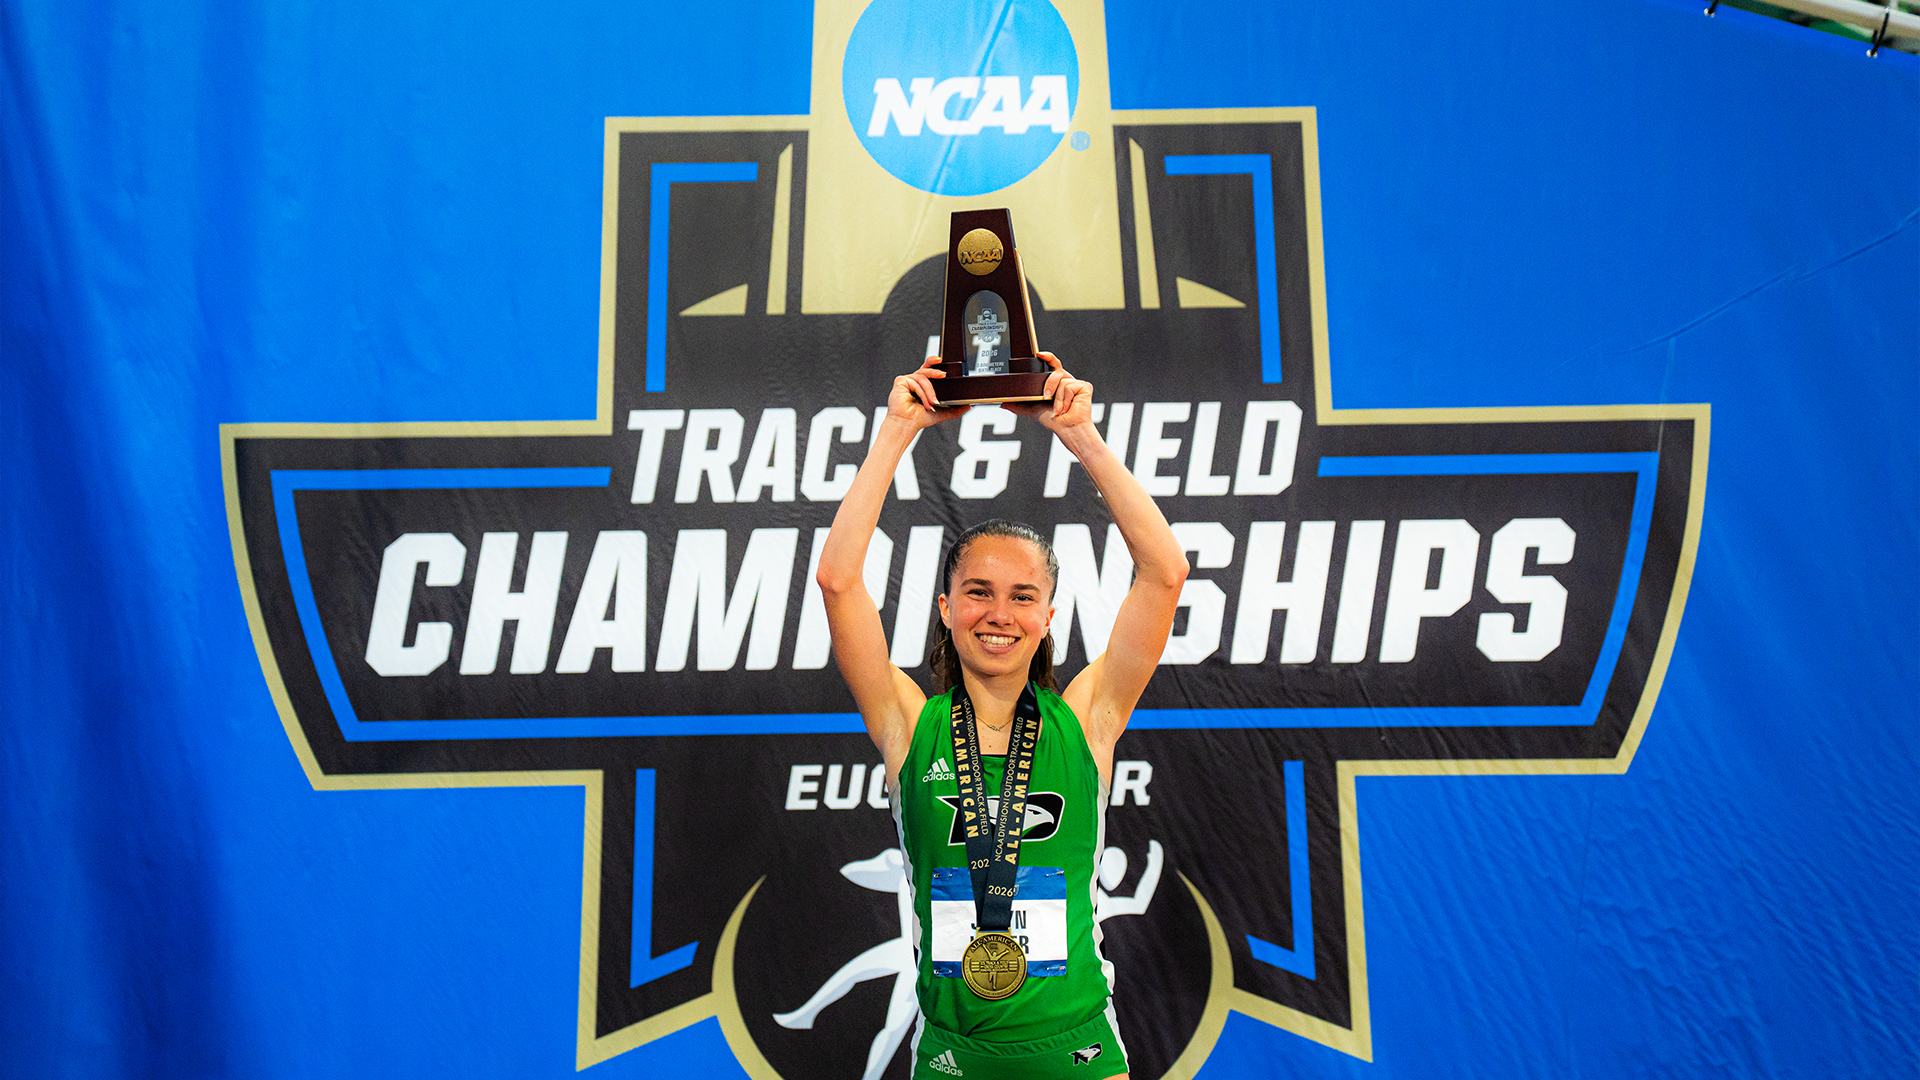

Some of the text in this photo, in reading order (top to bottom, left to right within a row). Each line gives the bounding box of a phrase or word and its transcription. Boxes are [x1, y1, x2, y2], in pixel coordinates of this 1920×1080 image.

[867, 75, 1071, 137] NCAA
[961, 249, 1003, 264] NCAA
[951, 403, 1022, 499] &
[365, 518, 1576, 677] CHAMPINSHIPS
[1015, 716, 1024, 733] FIELD
[1009, 739, 1020, 759] TRACK
[951, 704, 979, 838] ALL-AMERICAN
[970, 746, 982, 782] OUTDOOR
[922, 772, 956, 783] adidas
[1003, 759, 1016, 797] OUTDOOR
[975, 783, 985, 807] TRACK
[1004, 719, 1038, 865] ALL-AMERICAN
[980, 814, 989, 835] FIELD
[998, 802, 1009, 837] DIVISION
[994, 839, 1004, 862] NCAA
[971, 859, 990, 870] 202
[988, 885, 1014, 897] 2026
[929, 1060, 963, 1077] adidas
